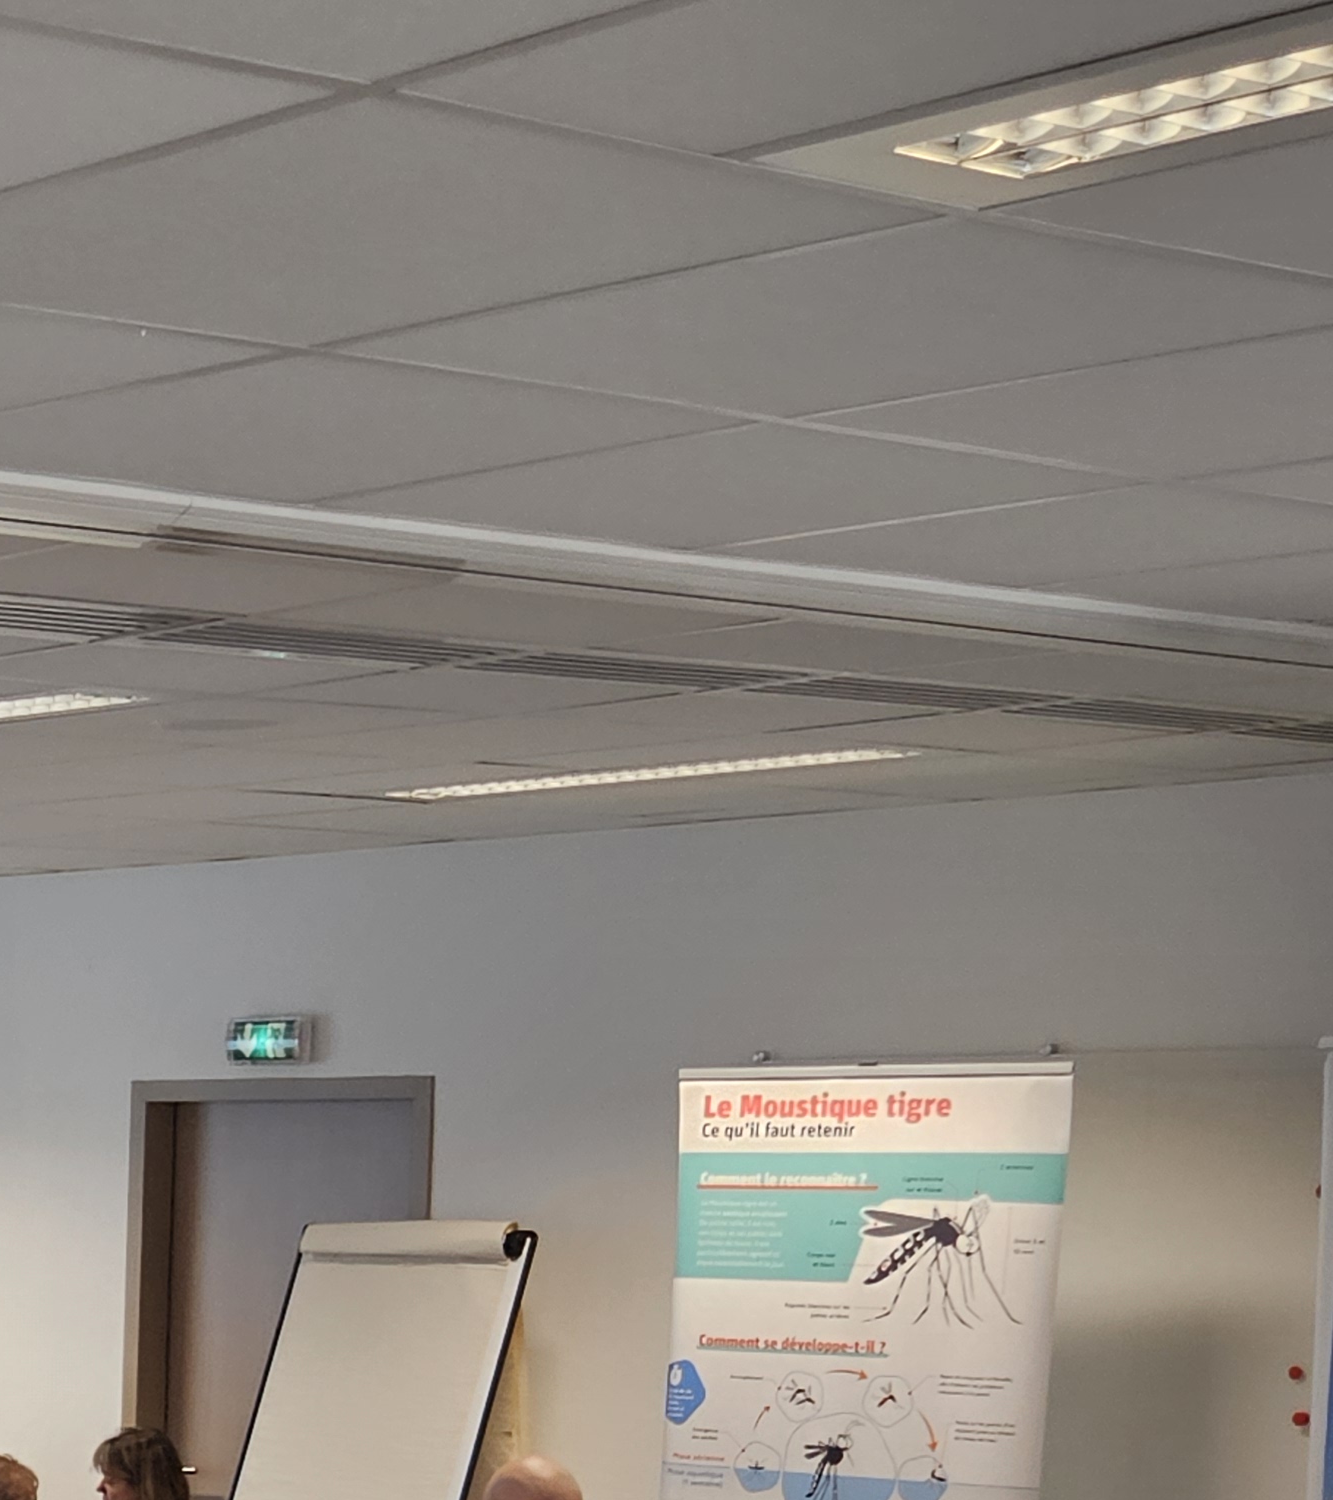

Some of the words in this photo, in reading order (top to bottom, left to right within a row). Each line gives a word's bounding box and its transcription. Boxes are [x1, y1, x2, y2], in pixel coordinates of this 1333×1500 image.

[703, 1094, 733, 1119] Le
[739, 1091, 879, 1122] Moustique
[886, 1091, 953, 1124] tigre
[701, 1122, 720, 1138] Ce
[724, 1122, 760, 1142] qu'il
[764, 1122, 795, 1138] faut
[800, 1122, 856, 1138] retenir
[700, 1171, 761, 1185] Comment
[859, 1173, 868, 1185] ?
[698, 1334, 760, 1350] Comment
[763, 1337, 778, 1350] se
[781, 1336, 876, 1356] développe-t-il
[879, 1341, 886, 1356] ?
